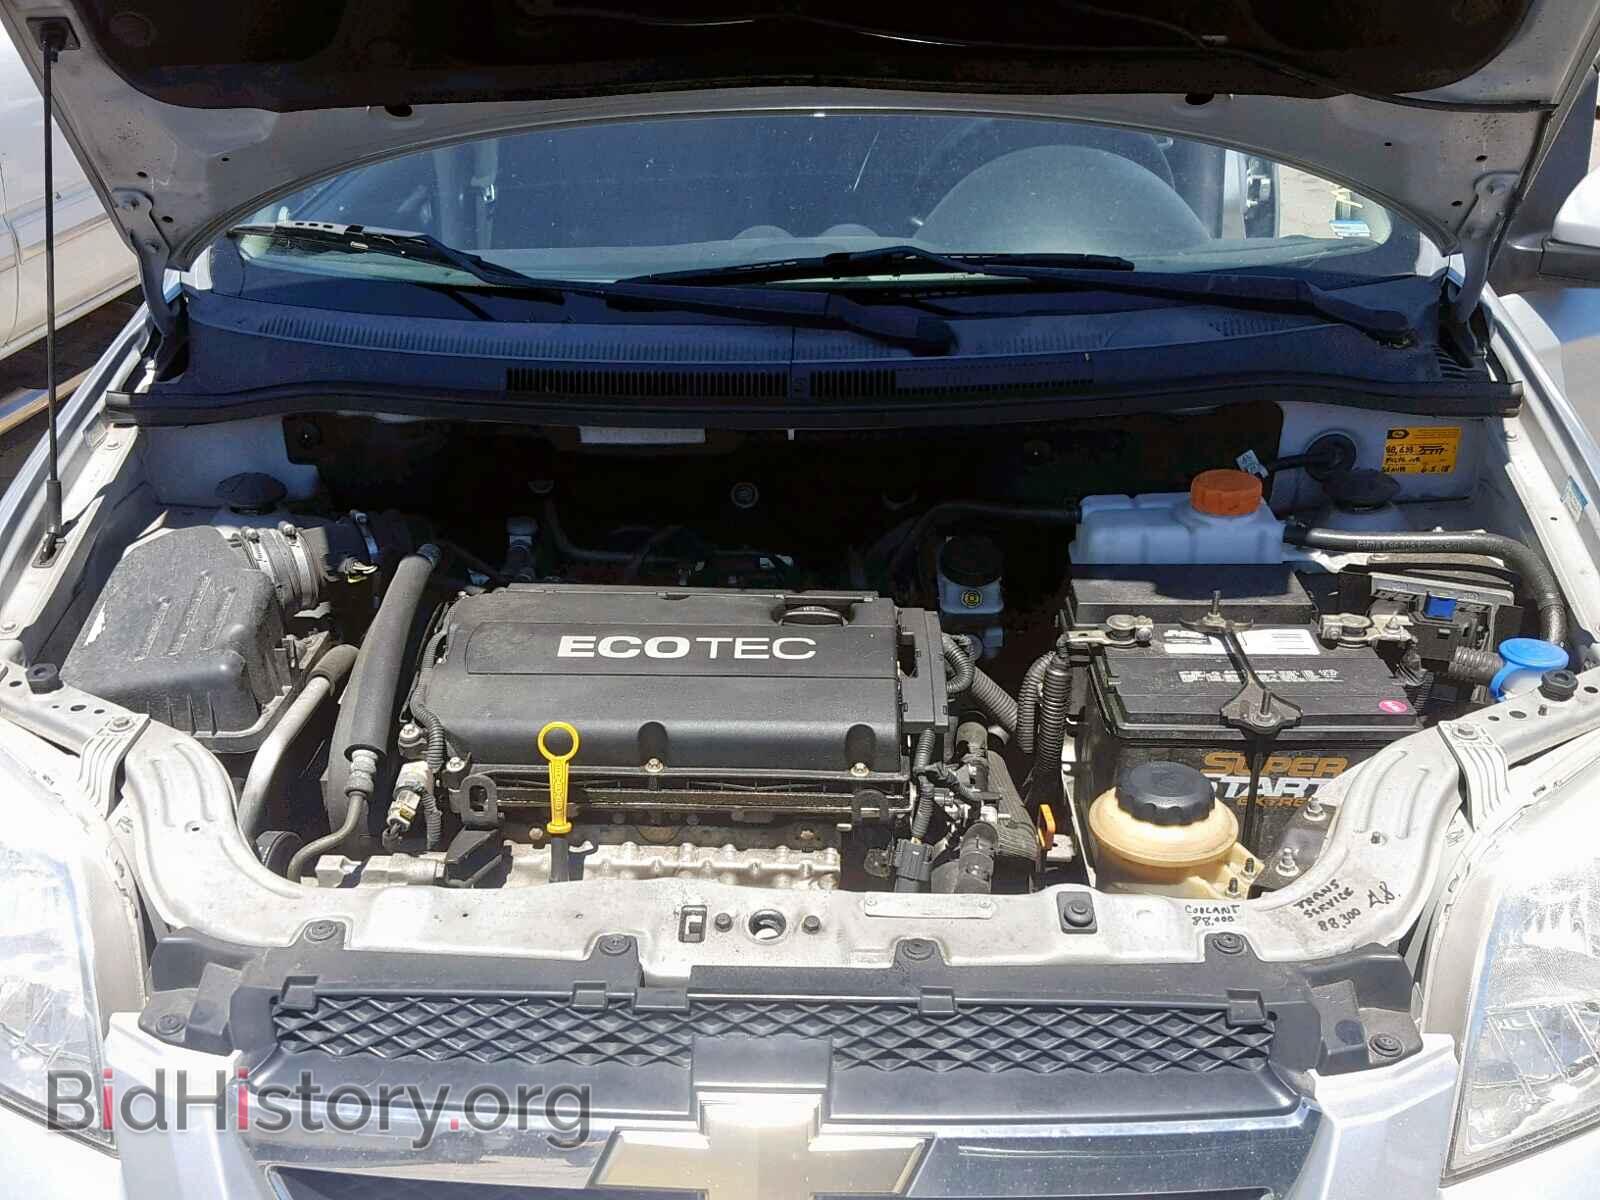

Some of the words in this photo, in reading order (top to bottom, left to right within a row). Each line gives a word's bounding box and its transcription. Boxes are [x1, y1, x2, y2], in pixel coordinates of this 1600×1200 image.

[557, 635, 817, 660] ECOTEC
[1200, 752, 1348, 777] SUPER
[1293, 878, 1341, 910] TRANS
[1303, 887, 1355, 919] SERVICE
[1184, 904, 1241, 915] COOLANT
